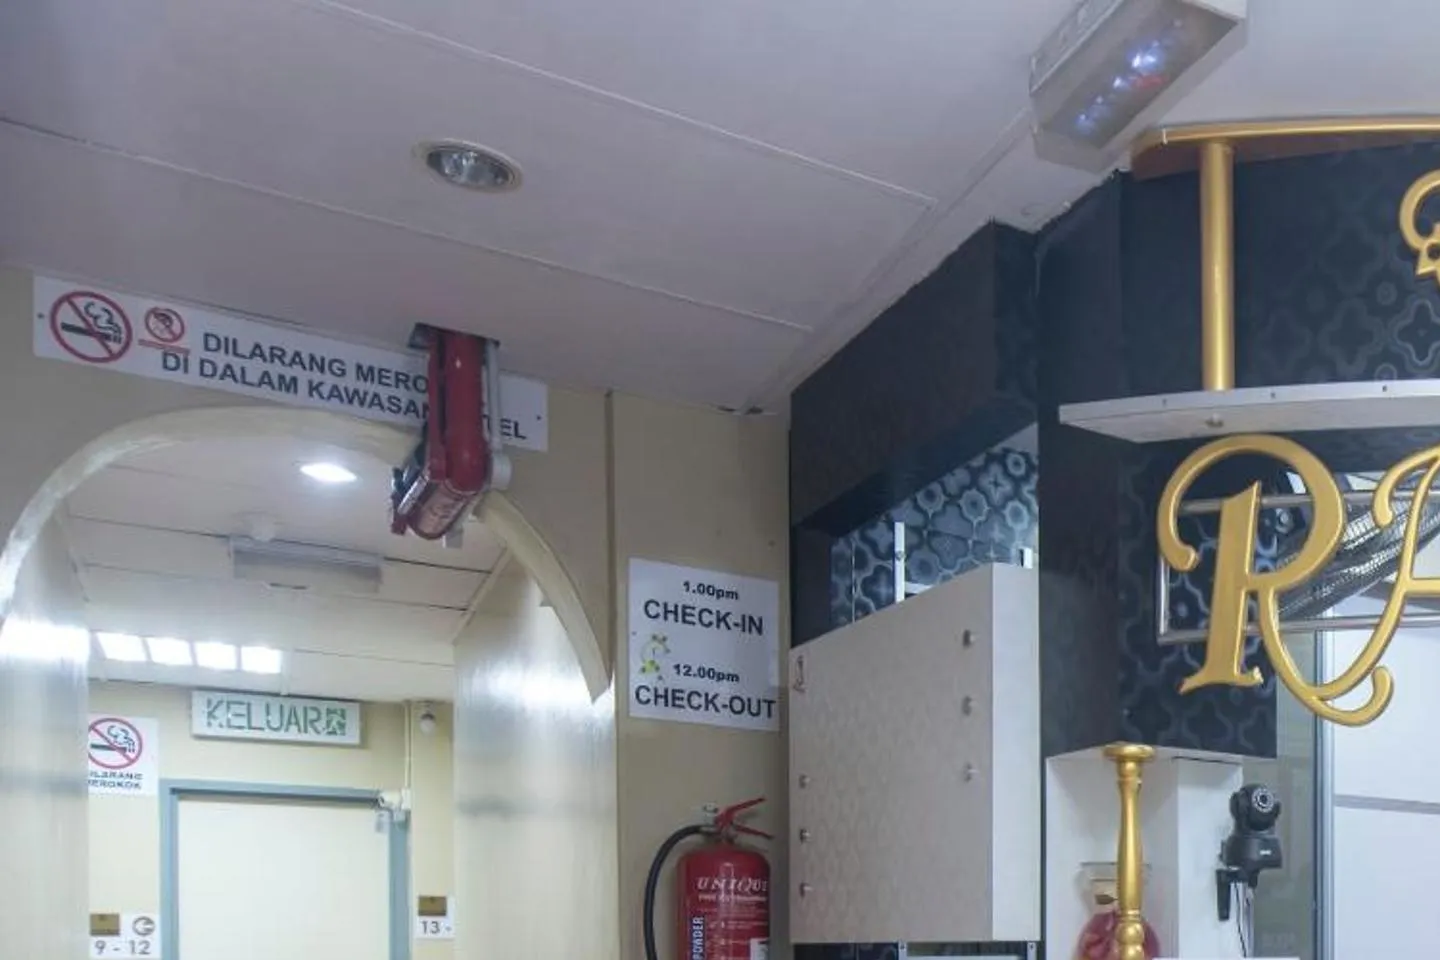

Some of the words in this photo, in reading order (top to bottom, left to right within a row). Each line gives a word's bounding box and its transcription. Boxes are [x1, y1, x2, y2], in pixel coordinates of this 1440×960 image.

[162, 352, 189, 374] DI
[200, 358, 299, 395] DALAM
[203, 332, 346, 378] DILARANG
[355, 362, 430, 393] MERO
[683, 580, 739, 600] 1.00pm
[644, 600, 763, 636] CHECK-IN
[673, 663, 740, 683] 12.00pm
[205, 699, 322, 734] KELUAR
[635, 685, 777, 719] CHECK-OUT
[421, 920, 440, 934] 13
[95, 940, 106, 955] 9
[129, 940, 151, 955] 12
